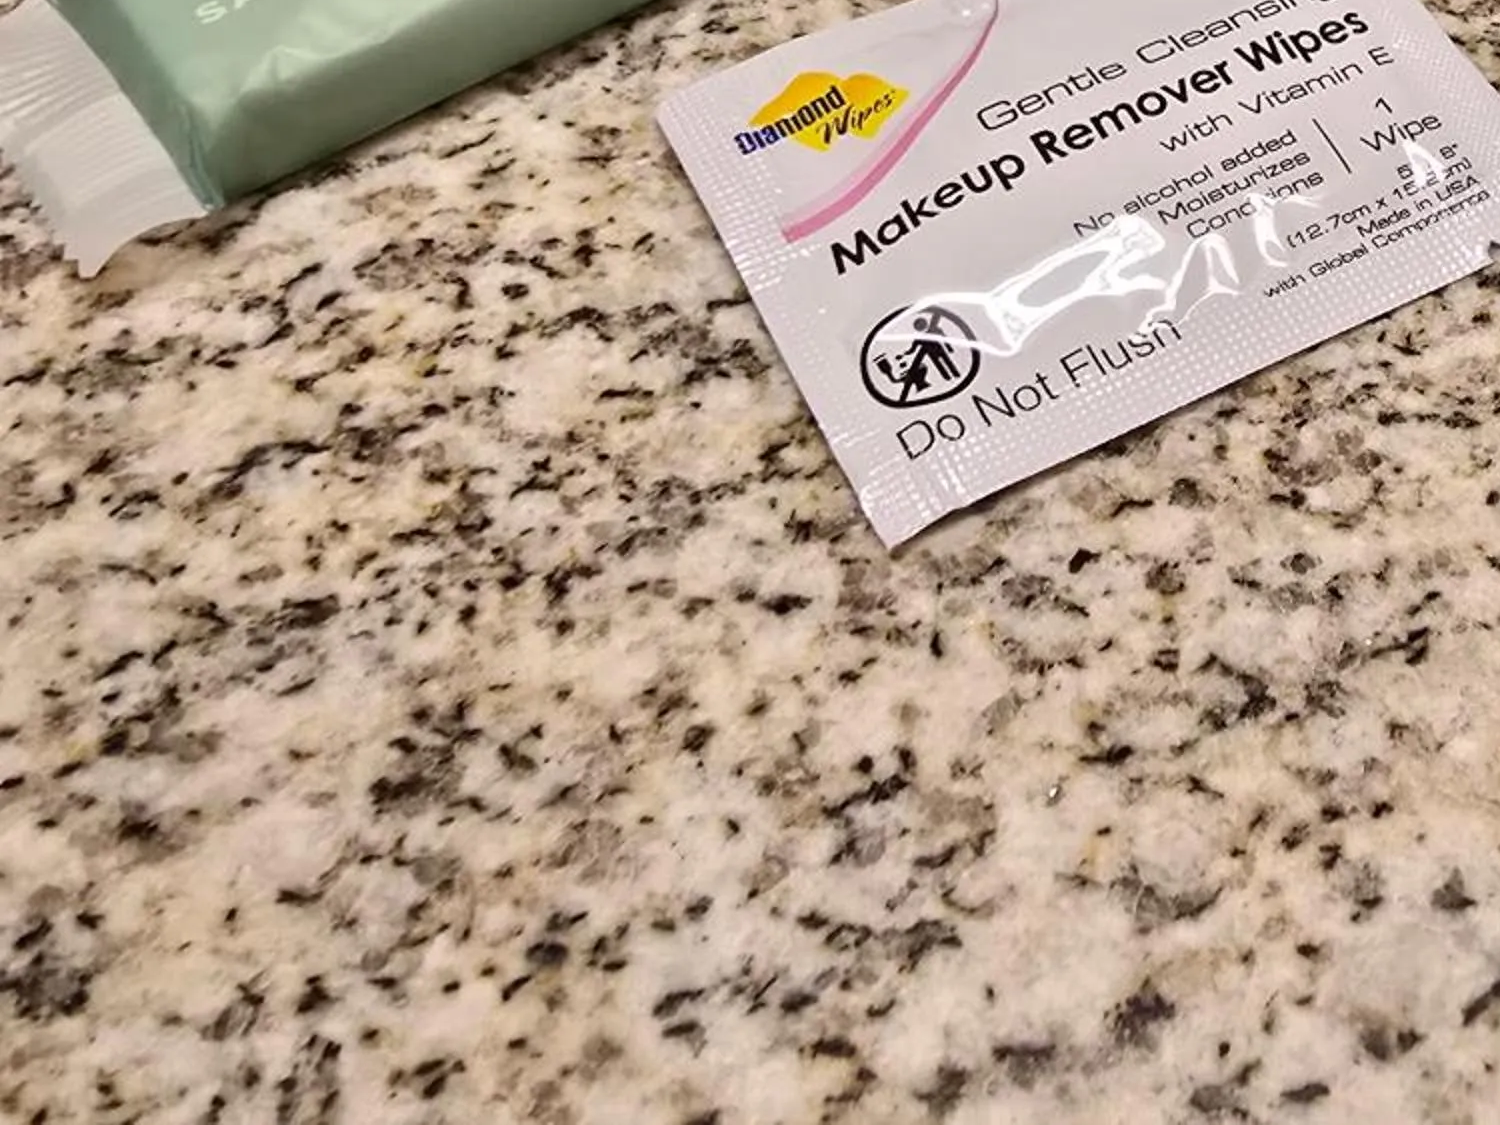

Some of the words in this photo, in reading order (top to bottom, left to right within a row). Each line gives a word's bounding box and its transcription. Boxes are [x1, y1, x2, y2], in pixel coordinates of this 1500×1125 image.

[733, 84, 847, 155] Diamond
[975, 62, 1129, 132] Gentle
[1159, 108, 1234, 154] with
[1236, 59, 1364, 114] Vitamin
[1367, 45, 1395, 68] E
[1374, 97, 1394, 115] 1
[829, 153, 1027, 277] Makeup
[1028, 59, 1235, 166] Remover
[1233, 8, 1370, 75] Wipes
[1359, 112, 1444, 154] Wipe
[1072, 211, 1116, 238] No
[1122, 164, 1213, 215] alcohol
[1220, 128, 1298, 173] added
[1157, 150, 1312, 225] Moisturizes
[1186, 172, 1325, 240] Condions
[1355, 206, 1412, 238] Made
[1414, 196, 1434, 214] in
[1434, 174, 1482, 203] USA
[1263, 272, 1307, 299] with
[1308, 242, 1370, 278] Global
[1371, 189, 1491, 250] Components
[1286, 202, 1373, 249] (12.7cm
[1375, 197, 1388, 211] x
[895, 413, 966, 461] Do
[971, 371, 1060, 428] Not
